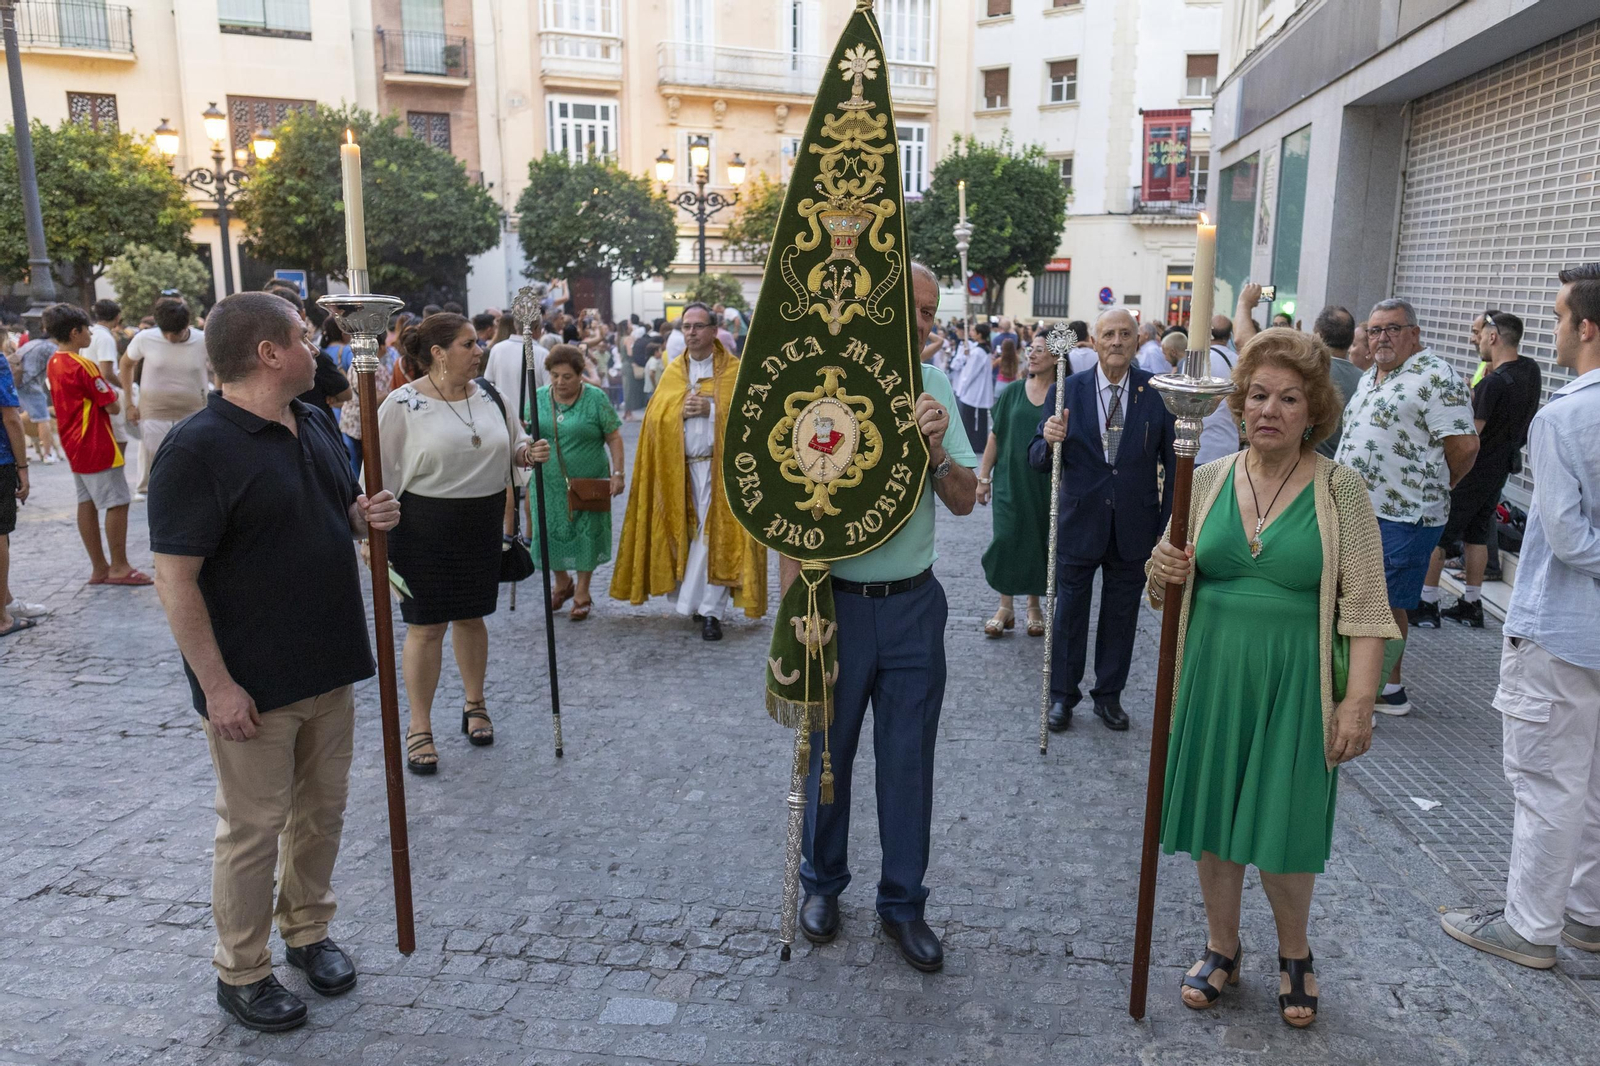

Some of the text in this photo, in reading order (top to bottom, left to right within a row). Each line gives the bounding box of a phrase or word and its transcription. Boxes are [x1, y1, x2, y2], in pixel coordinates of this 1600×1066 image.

[741, 335, 916, 436] SANTA MARTA
[734, 451, 913, 550] ORA PRO NOBIS
